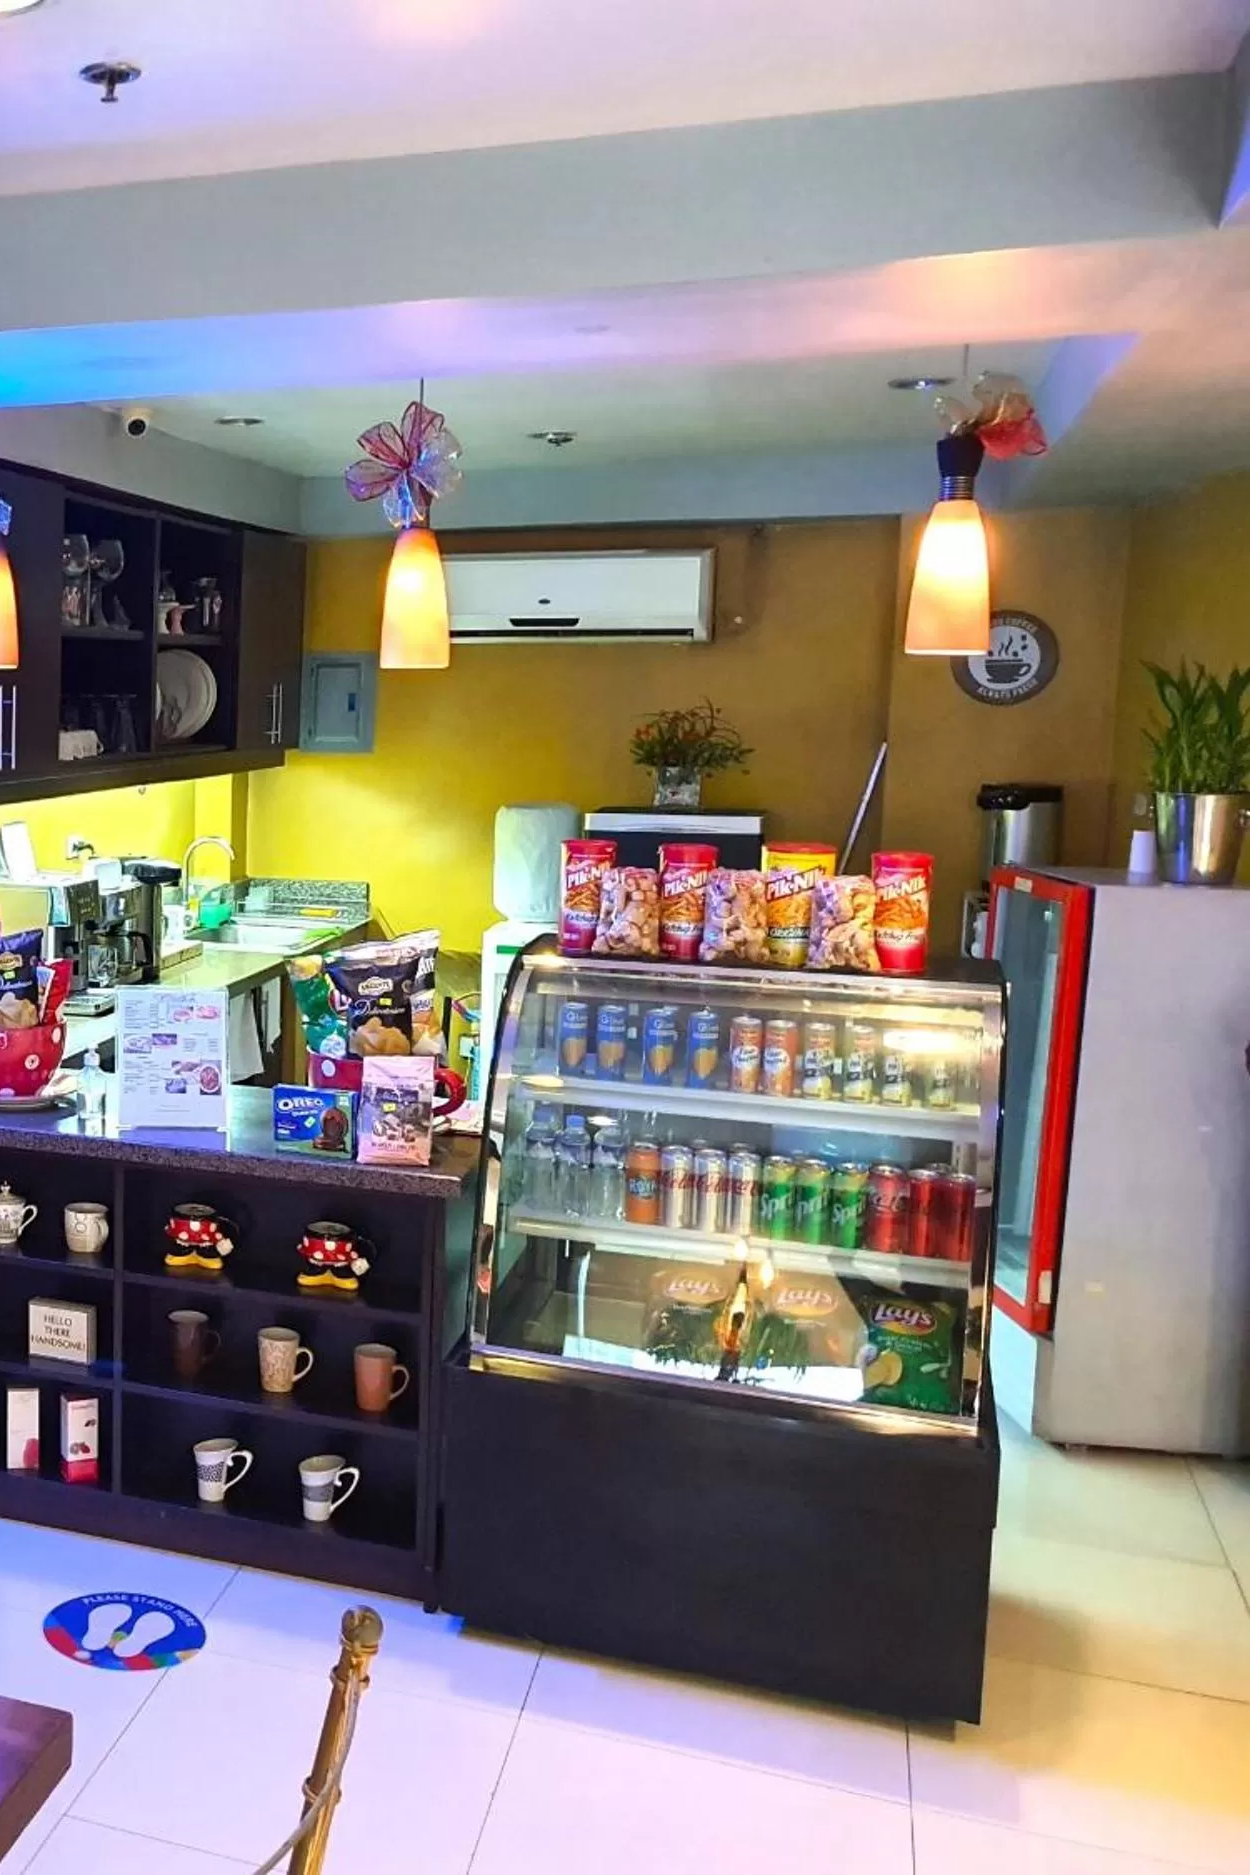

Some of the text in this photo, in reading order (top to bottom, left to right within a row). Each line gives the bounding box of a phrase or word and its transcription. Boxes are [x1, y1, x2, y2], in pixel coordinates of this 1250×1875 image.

[278, 1096, 323, 1111] OREO
[44, 1313, 73, 1327] HELLO
[44, 1325, 70, 1338] THERE
[31, 1333, 86, 1352] HANDSOME!
[133, 1595, 175, 1611] STAND
